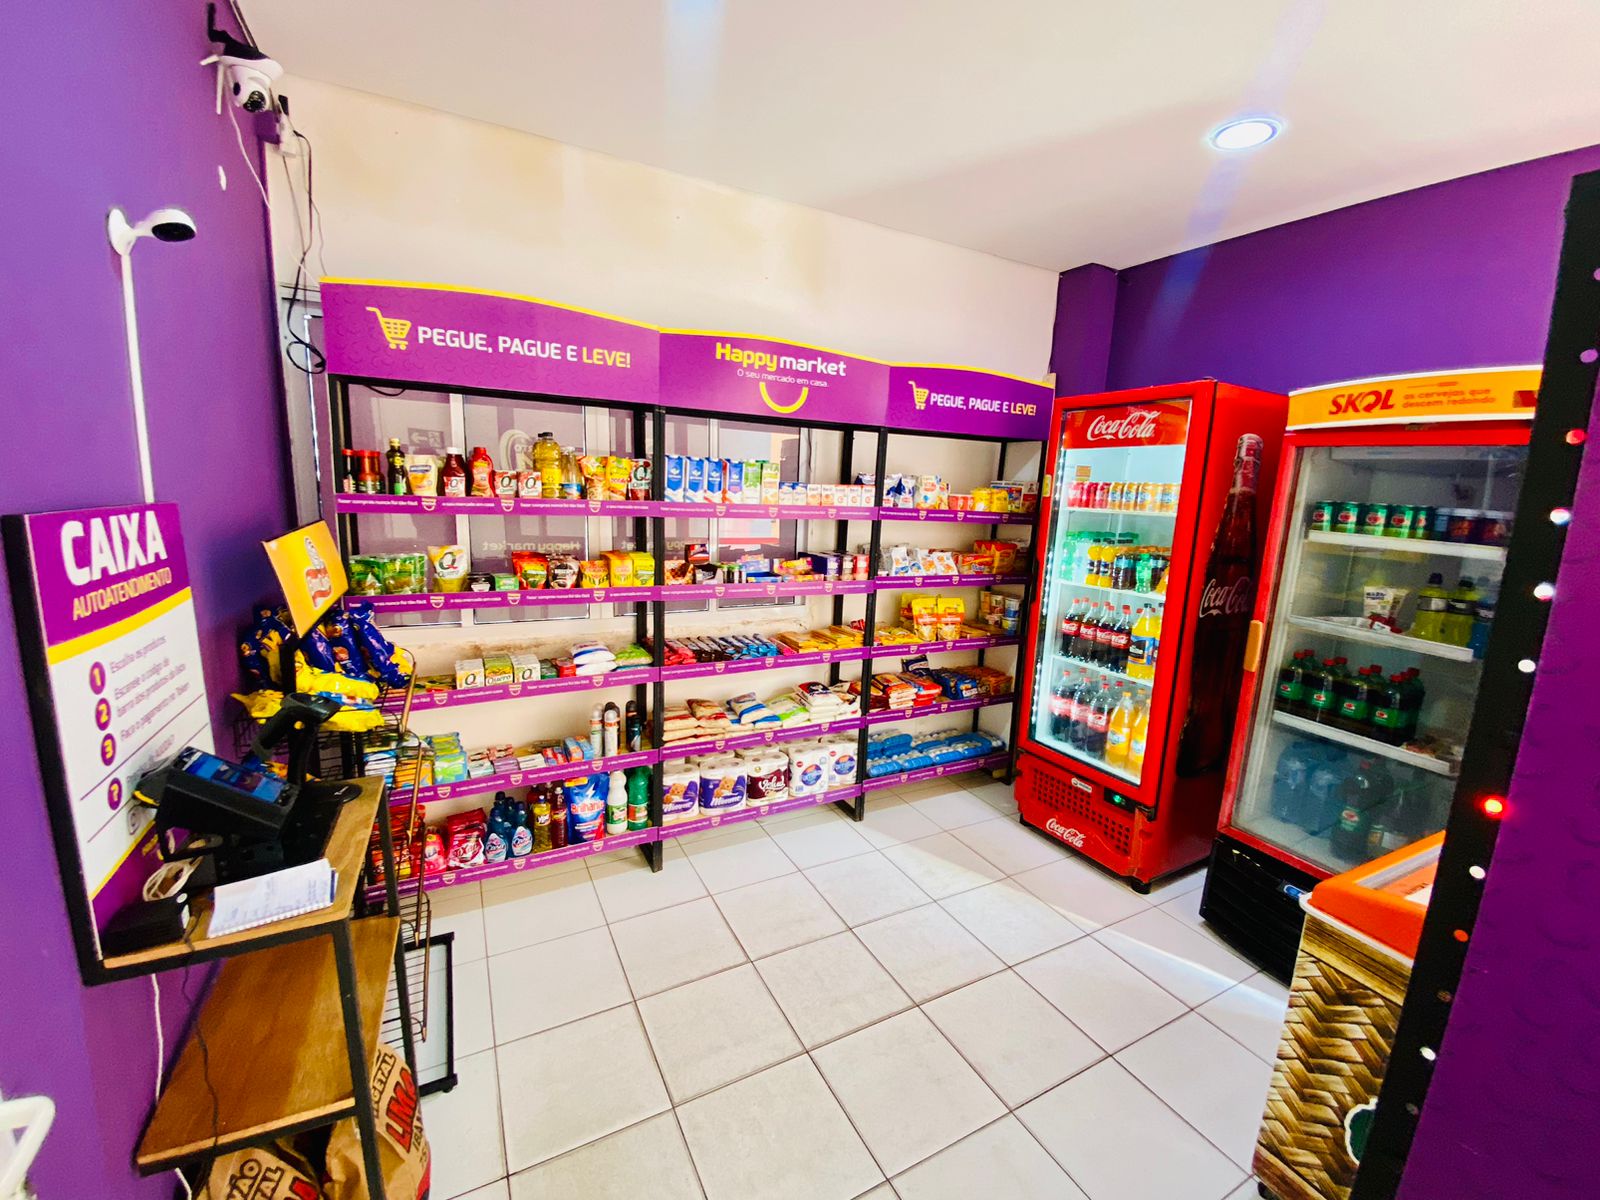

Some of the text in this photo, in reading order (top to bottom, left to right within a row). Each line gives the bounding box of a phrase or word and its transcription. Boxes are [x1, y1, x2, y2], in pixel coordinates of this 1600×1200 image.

[417, 326, 631, 369] PEGUE, PAGUE E LEVE!
[715, 342, 847, 377] Happy market
[736, 368, 745, 377] O
[745, 371, 760, 379] seu
[761, 373, 796, 384] mercado
[930, 392, 1037, 416] PEGUE, PAGUE E LEVE!
[1328, 388, 1396, 416] SKOL
[1086, 410, 1162, 441] Coca-Cola
[60, 510, 168, 586] CAIXA
[72, 566, 173, 621] AUTOATENDIMENTO
[1046, 818, 1086, 847] Coca-Cola
